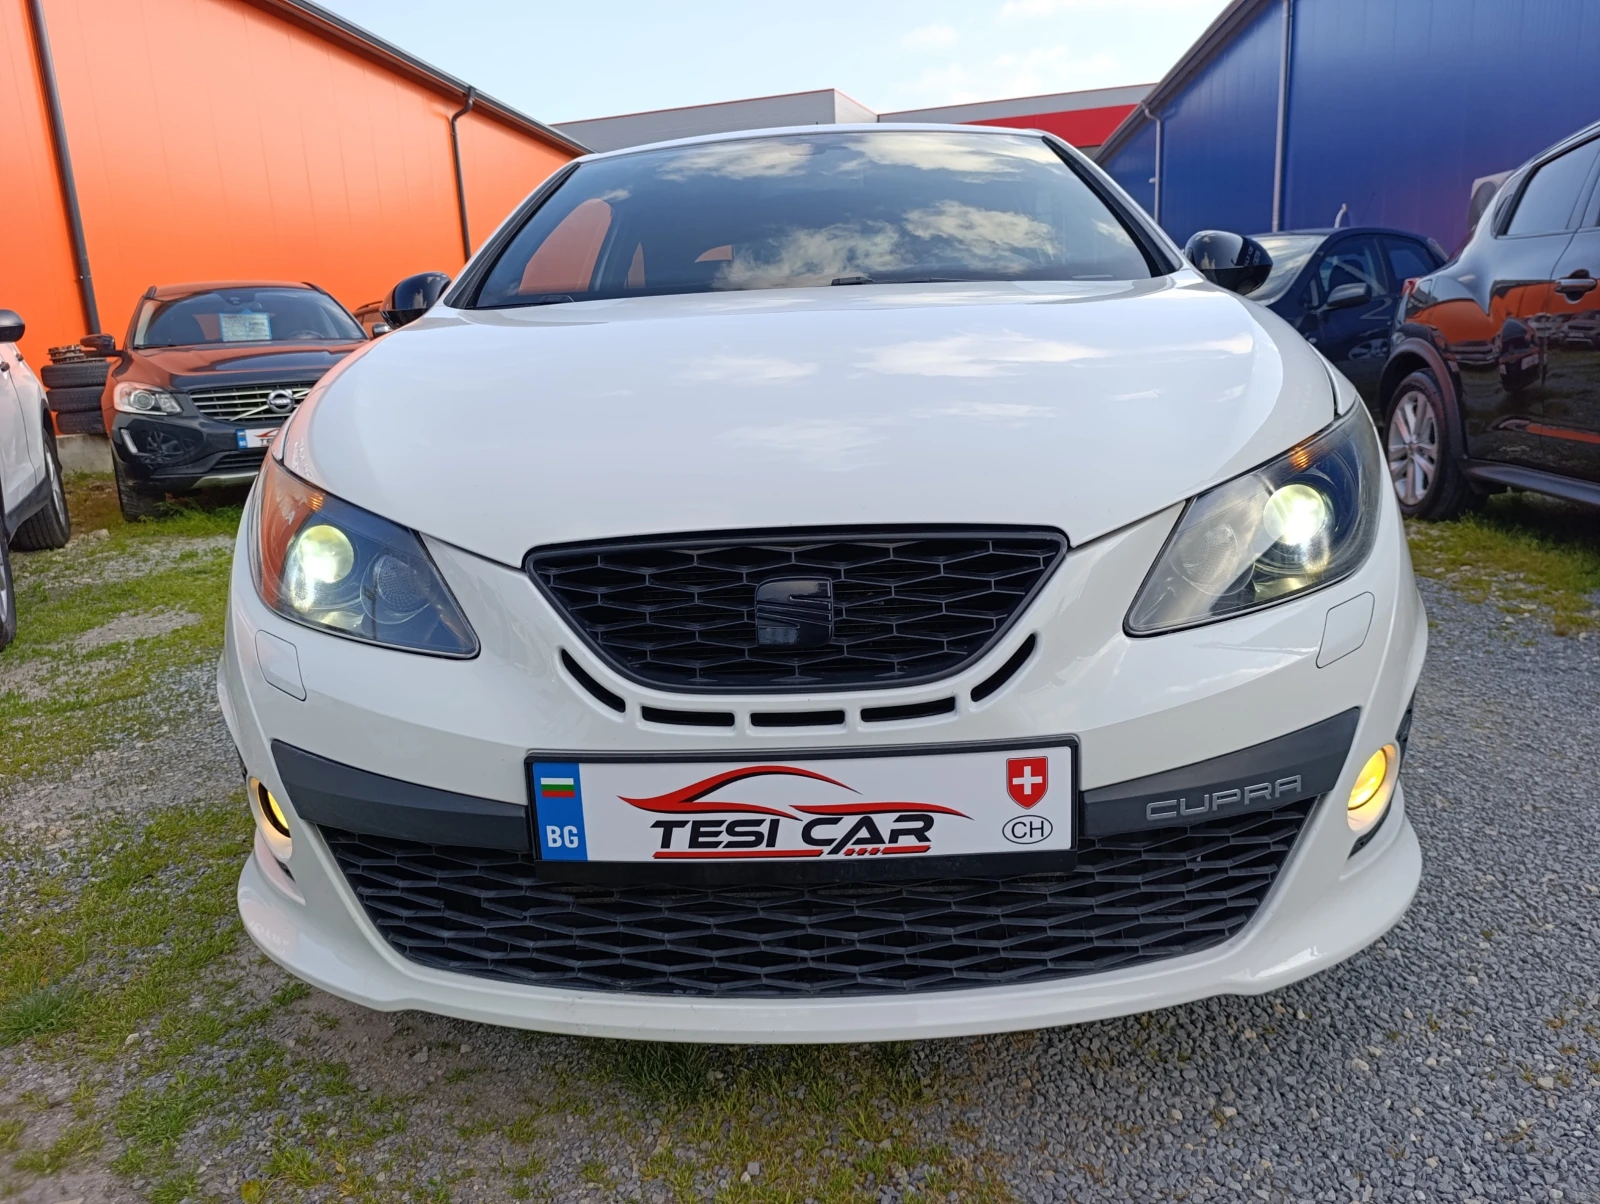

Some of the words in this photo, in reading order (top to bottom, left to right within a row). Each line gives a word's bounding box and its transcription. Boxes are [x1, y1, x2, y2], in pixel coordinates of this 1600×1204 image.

[1146, 774, 1302, 821] CUPRA
[546, 825, 579, 849] BG
[650, 818, 781, 850] TESI
[801, 813, 935, 856] CAR
[1011, 820, 1045, 839] CH
